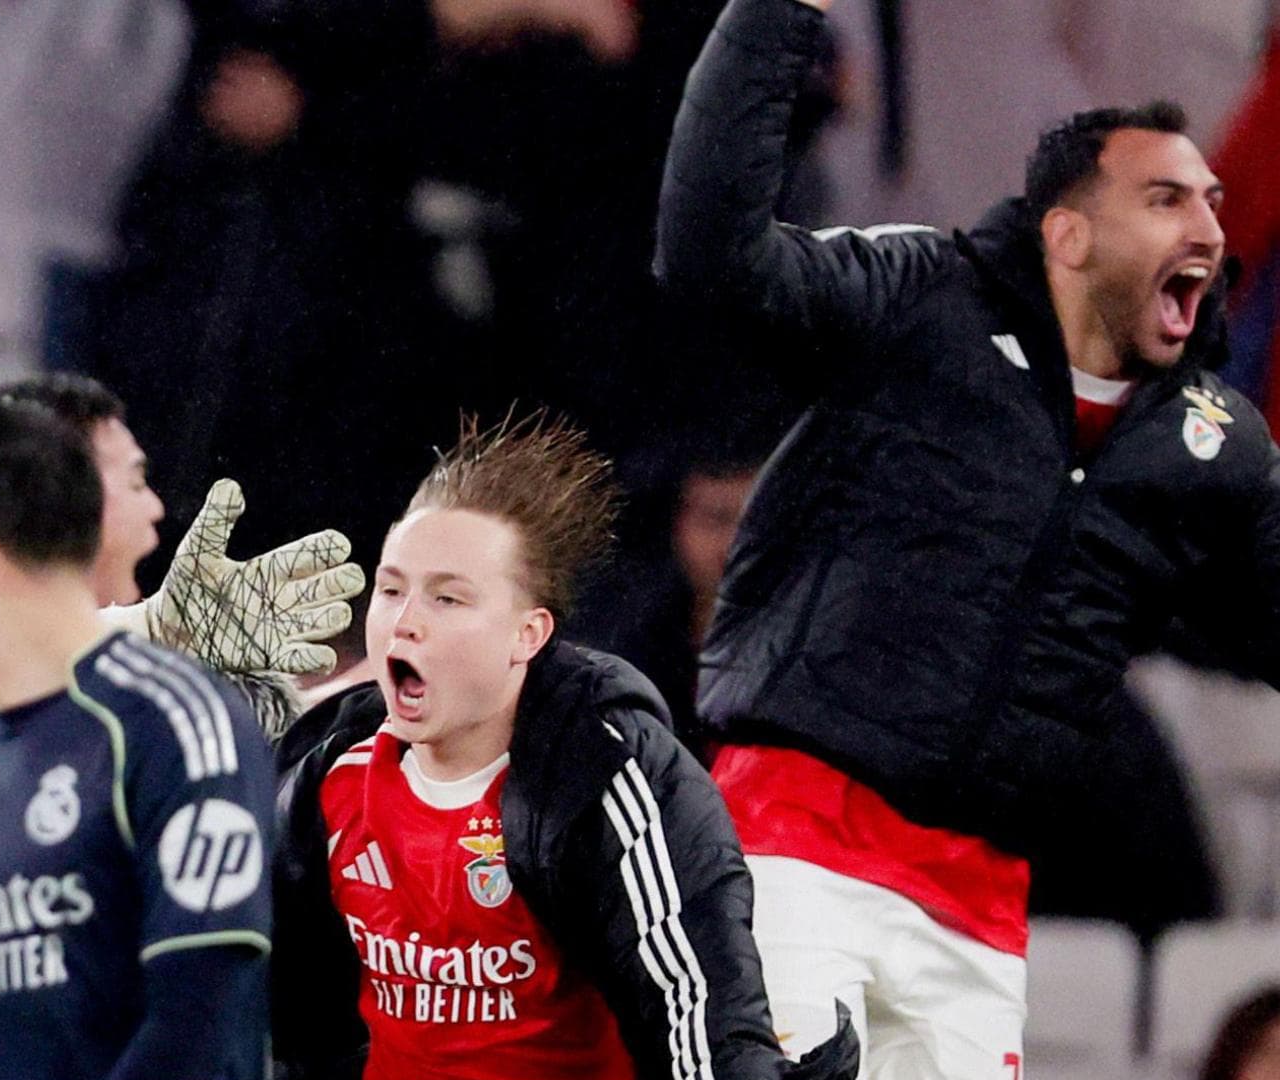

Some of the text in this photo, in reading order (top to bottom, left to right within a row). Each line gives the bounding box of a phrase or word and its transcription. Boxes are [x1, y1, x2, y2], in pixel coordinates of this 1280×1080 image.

[175, 799, 254, 912] hp
[345, 913, 536, 986] Emirates
[415, 983, 517, 1023] BETTER
